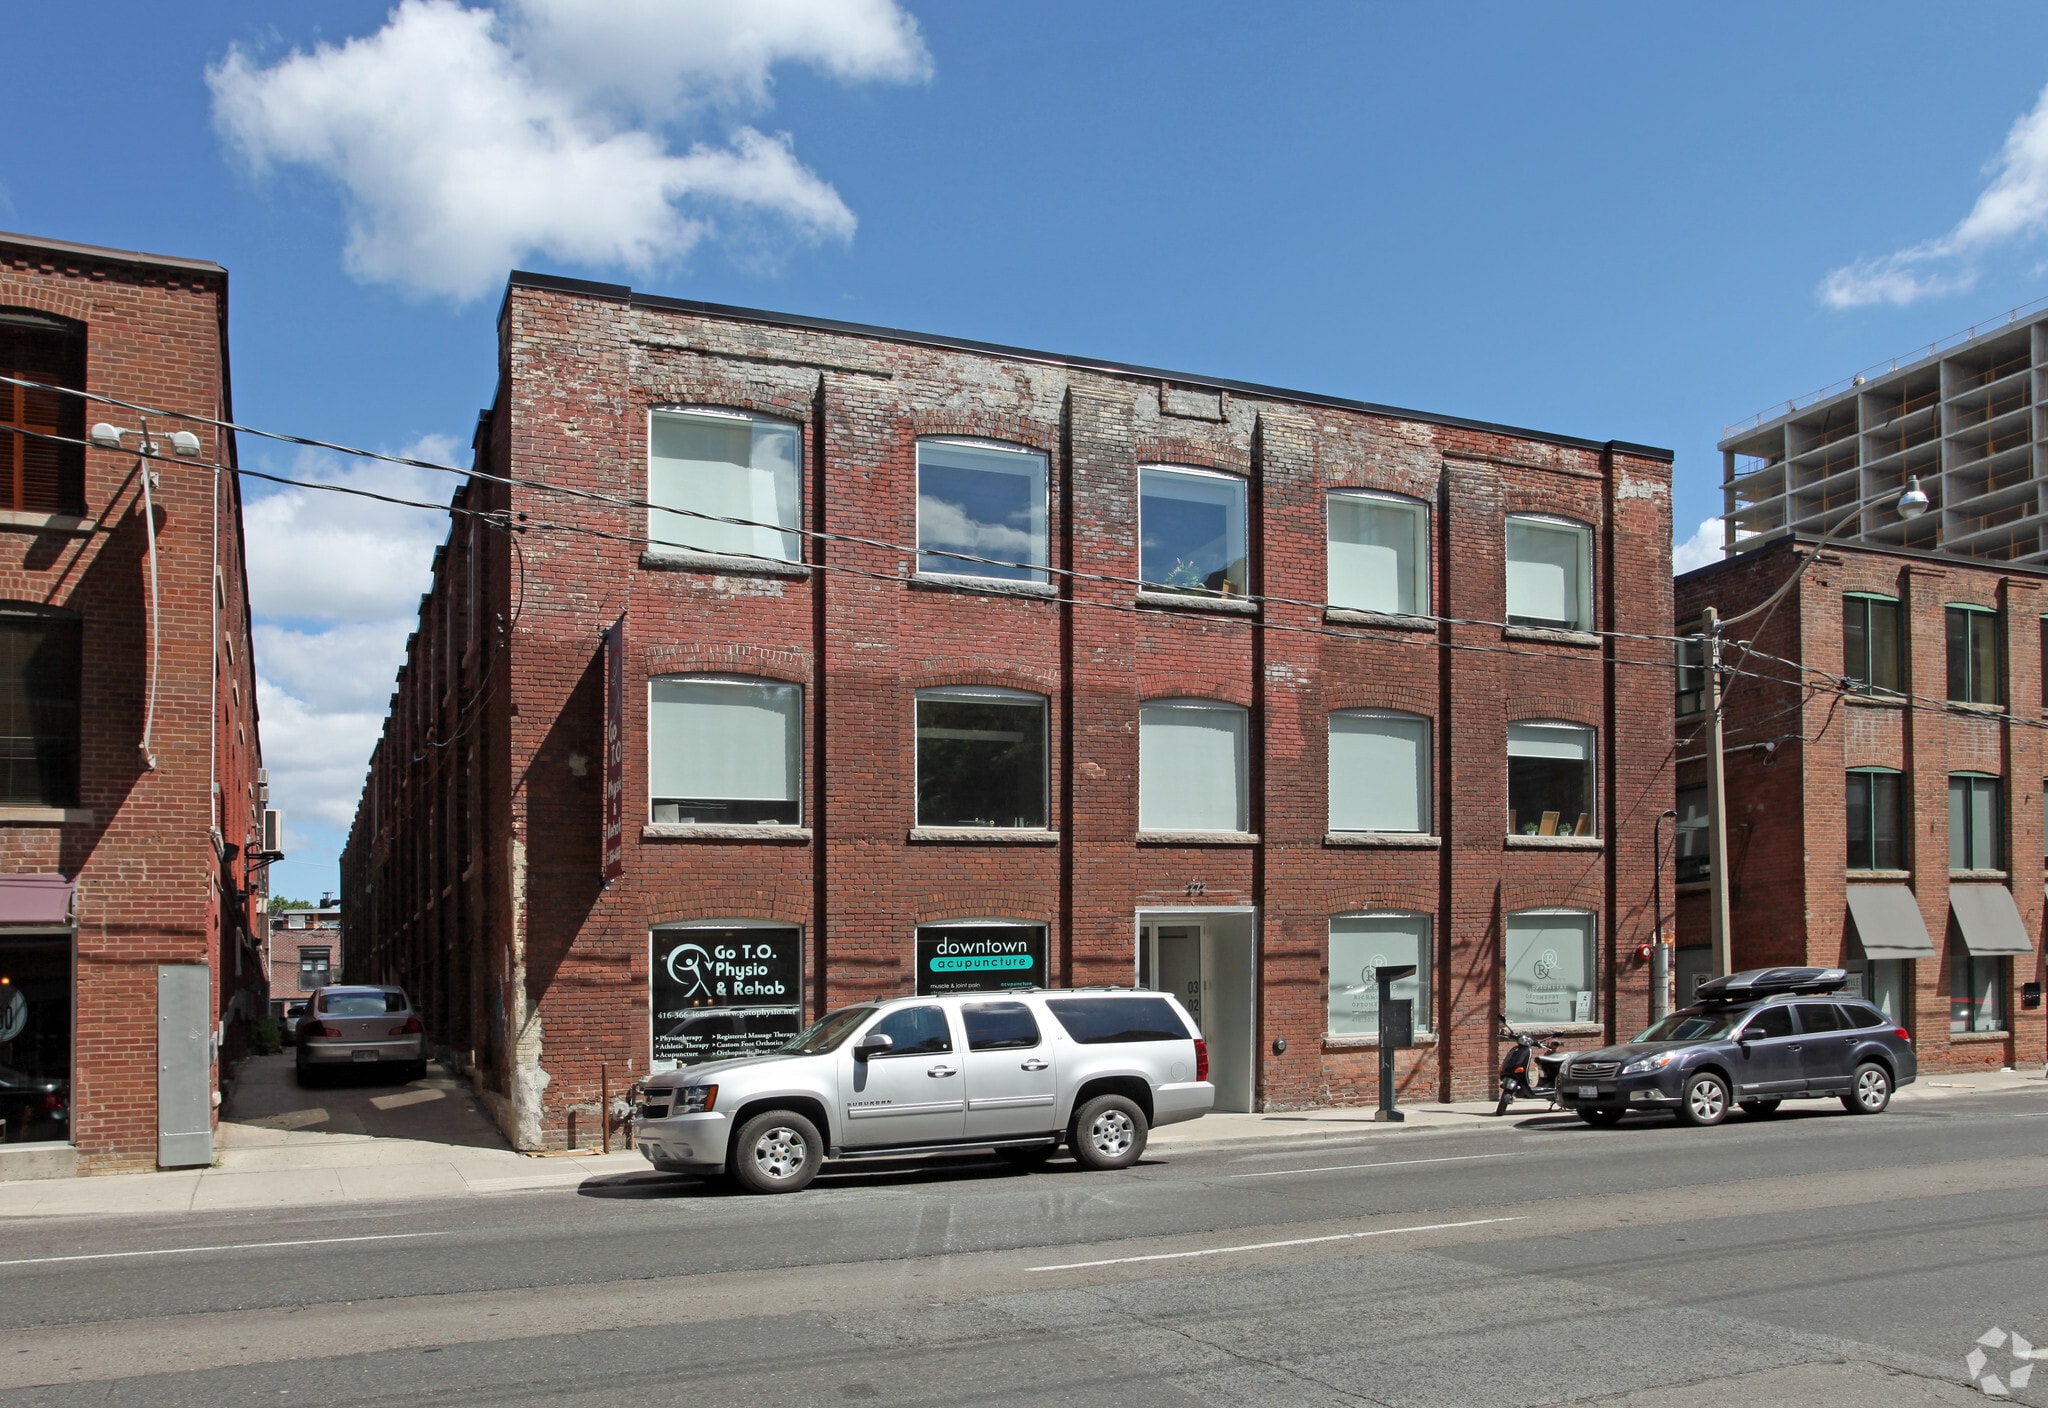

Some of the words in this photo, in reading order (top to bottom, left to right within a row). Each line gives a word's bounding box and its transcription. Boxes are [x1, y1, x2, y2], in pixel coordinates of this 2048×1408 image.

[608, 720, 617, 743] Go
[714, 945, 736, 959] Go
[742, 944, 777, 959] T.O.
[936, 936, 1027, 955] downtown
[937, 957, 1026, 969] acupuncture
[715, 962, 768, 980] Physio
[716, 981, 727, 996] &
[733, 980, 786, 996] Rehab
[1187, 980, 1199, 994] 03
[1187, 998, 1199, 1012] 02
[659, 1034, 704, 1042] Physiotherapy
[716, 1033, 747, 1041] Registered
[686, 1042, 710, 1050] Therapy
